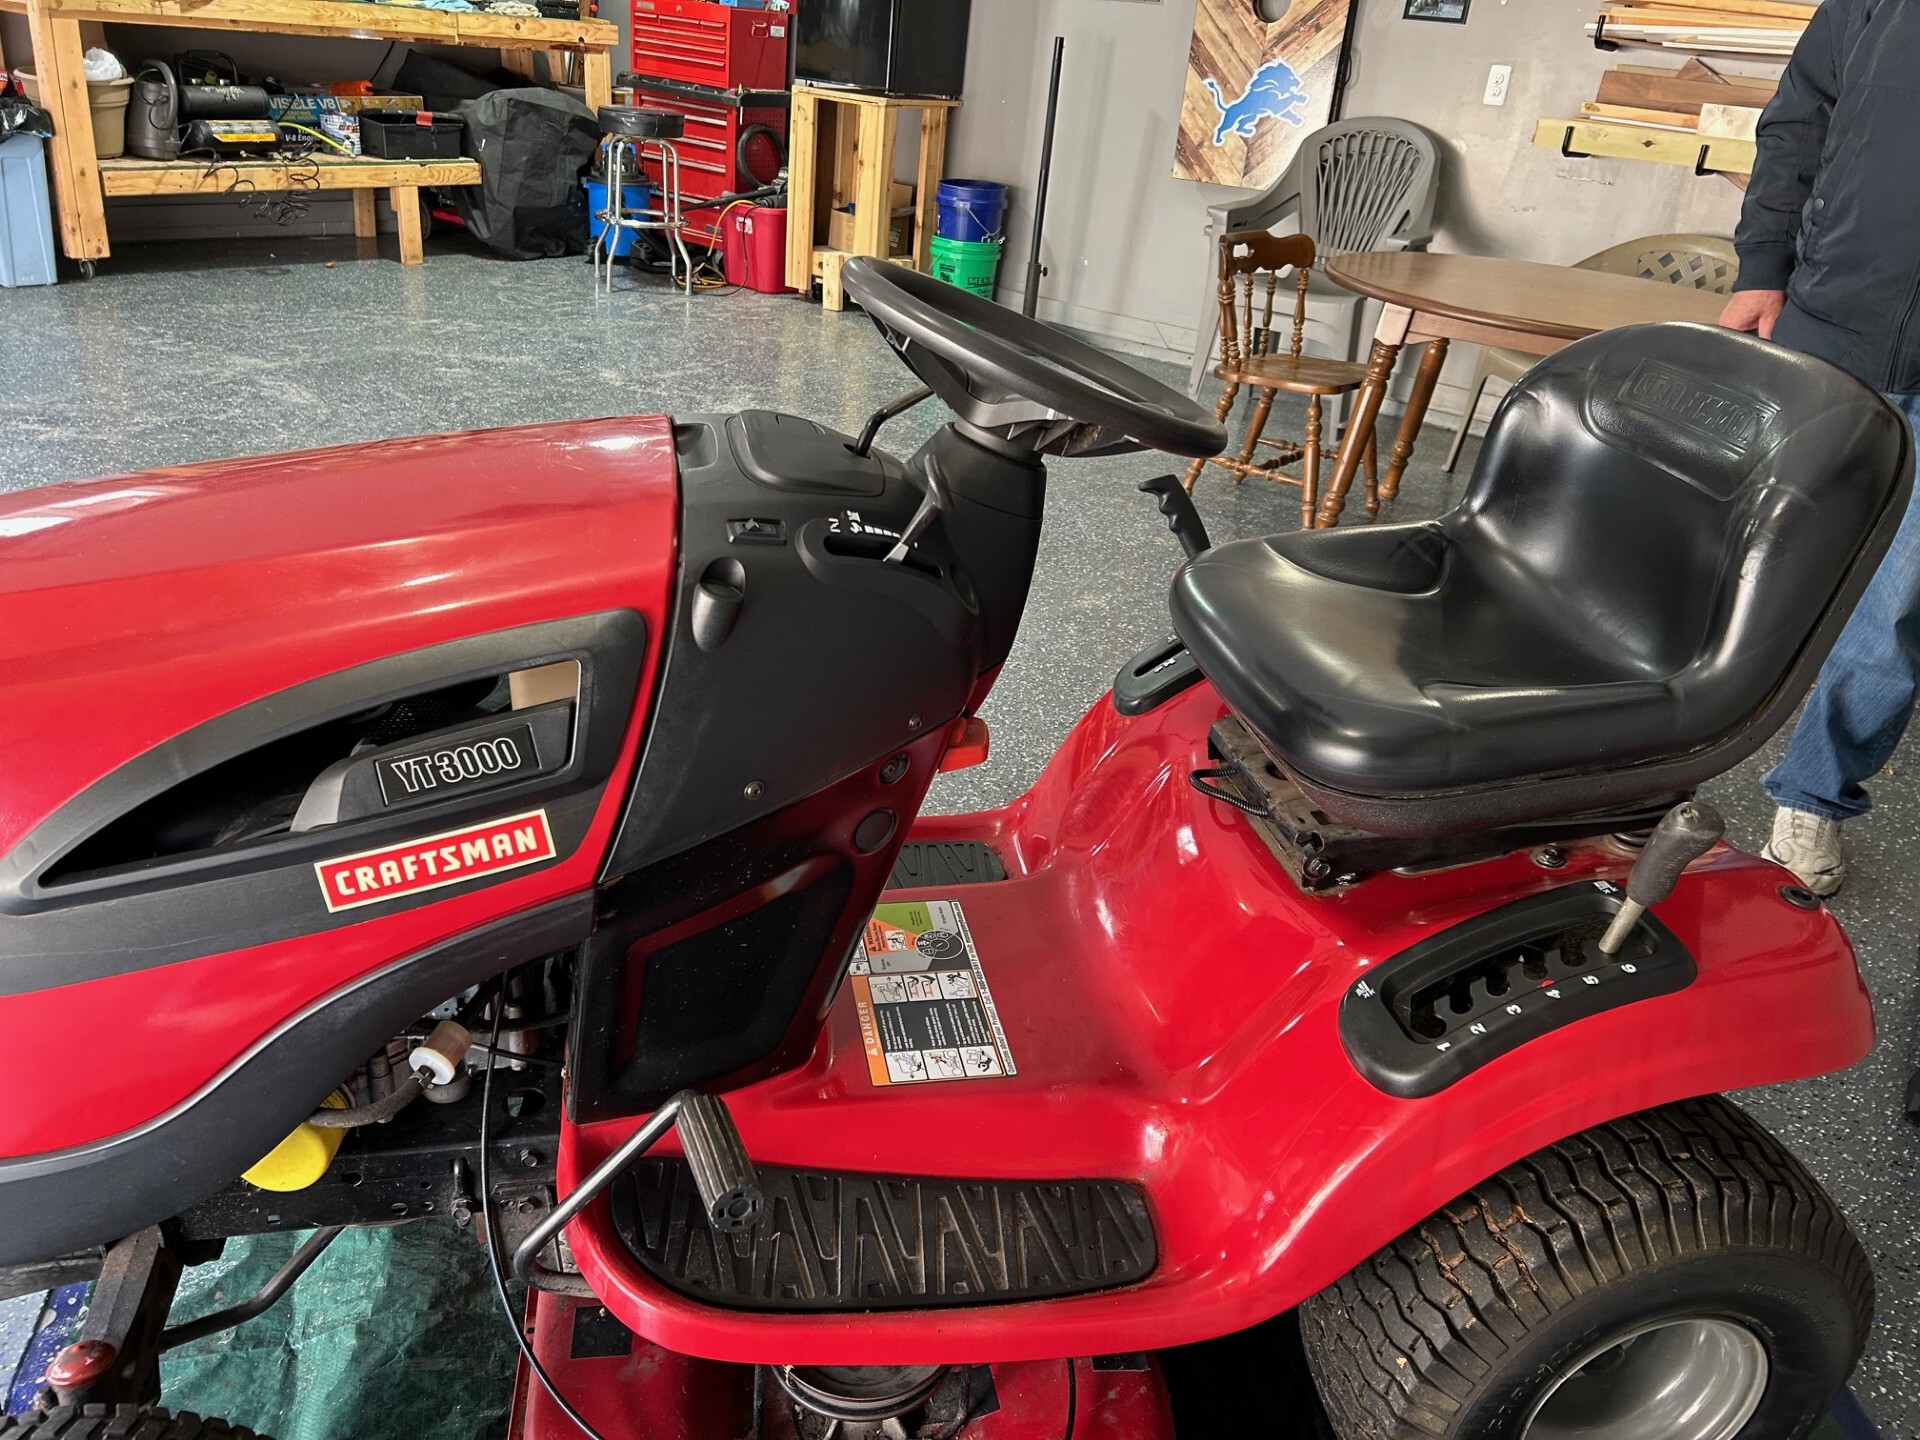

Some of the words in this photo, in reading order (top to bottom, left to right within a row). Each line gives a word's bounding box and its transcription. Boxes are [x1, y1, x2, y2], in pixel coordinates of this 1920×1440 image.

[317, 98, 337, 110] V8
[1633, 372, 1763, 445] CRAFTSMAN
[391, 756, 437, 793] YT
[434, 737, 522, 783] 3000
[335, 826, 538, 896] CRAFTSMAN
[858, 1001, 877, 1045] DANGER
[1436, 1041, 1451, 1052] 1
[1470, 1022, 1487, 1035] 2
[1506, 1004, 1522, 1015] 3
[1545, 989, 1561, 999] 4
[1582, 975, 1599, 986] 5
[1620, 963, 1637, 974] 6
